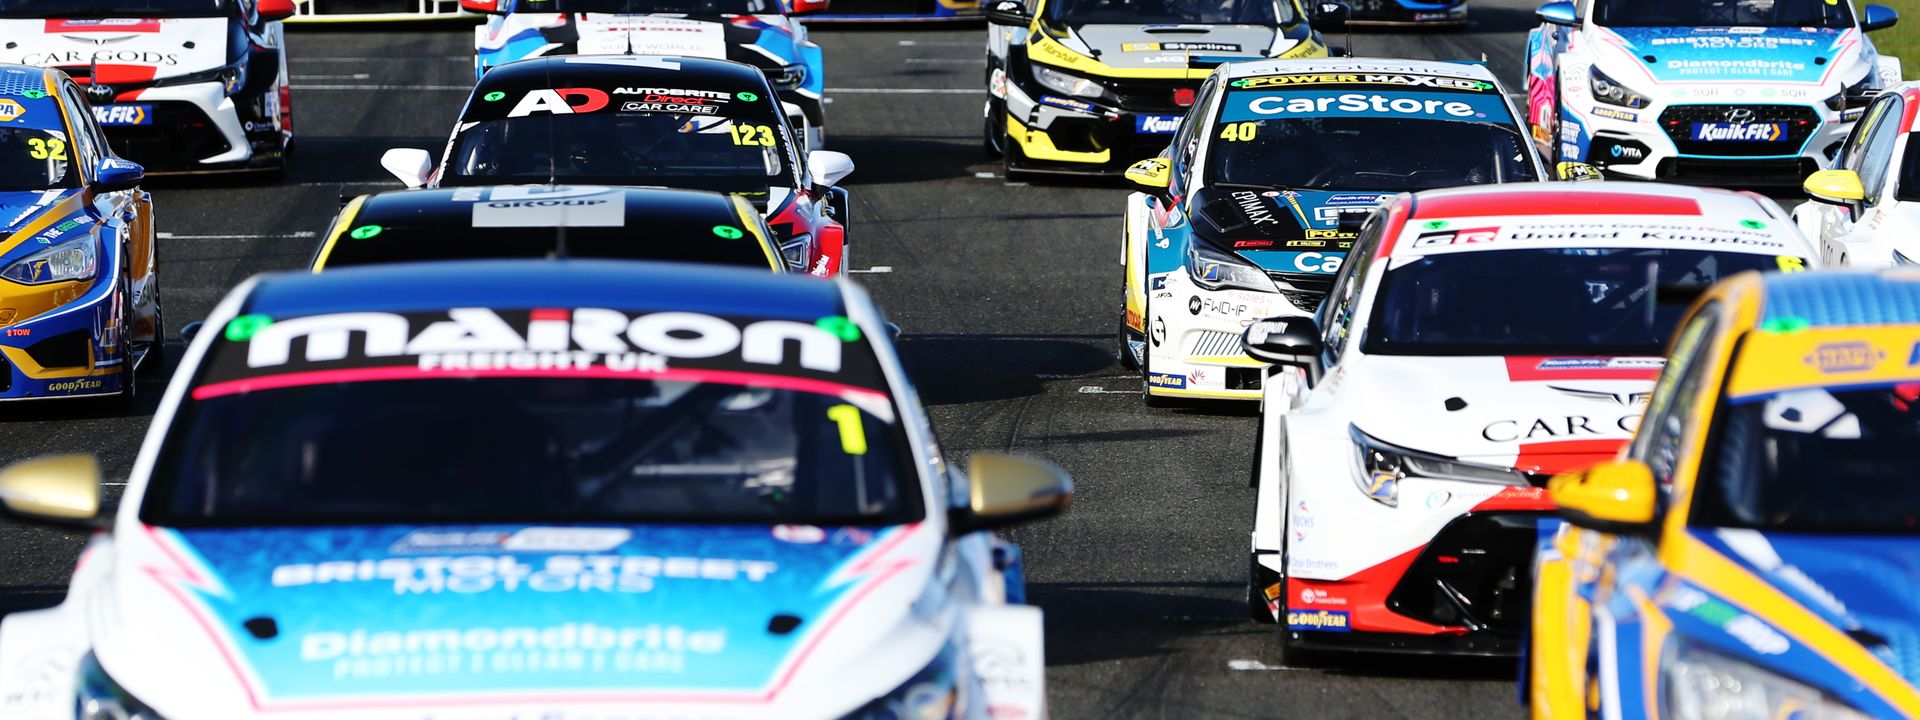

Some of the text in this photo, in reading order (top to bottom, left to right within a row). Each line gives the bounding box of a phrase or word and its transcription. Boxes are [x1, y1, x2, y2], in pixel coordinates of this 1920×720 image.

[1740, 37, 1816, 46] STREET
[21, 50, 178, 66] CAR GODS
[1667, 59, 1806, 70] Diamondbrite
[1247, 75, 1478, 89] POWER MAXED
[612, 87, 731, 99] AUTOBRITE
[644, 94, 706, 105] Direct
[626, 102, 713, 113] CAR CARE
[730, 125, 776, 147] 123
[1220, 122, 1257, 142] 40
[28, 138, 67, 160] 32
[1622, 147, 1642, 158] VITA
[487, 199, 608, 209] GROUP
[1231, 191, 1275, 225] EPIMAX
[1511, 230, 1784, 248] United Kingdom
[418, 351, 669, 372] FREIGHT UK
[49, 378, 103, 391] GOODYEAR
[826, 403, 867, 454] 1
[1482, 415, 1600, 442] CAR
[1287, 610, 1347, 629] GOODYEAR
